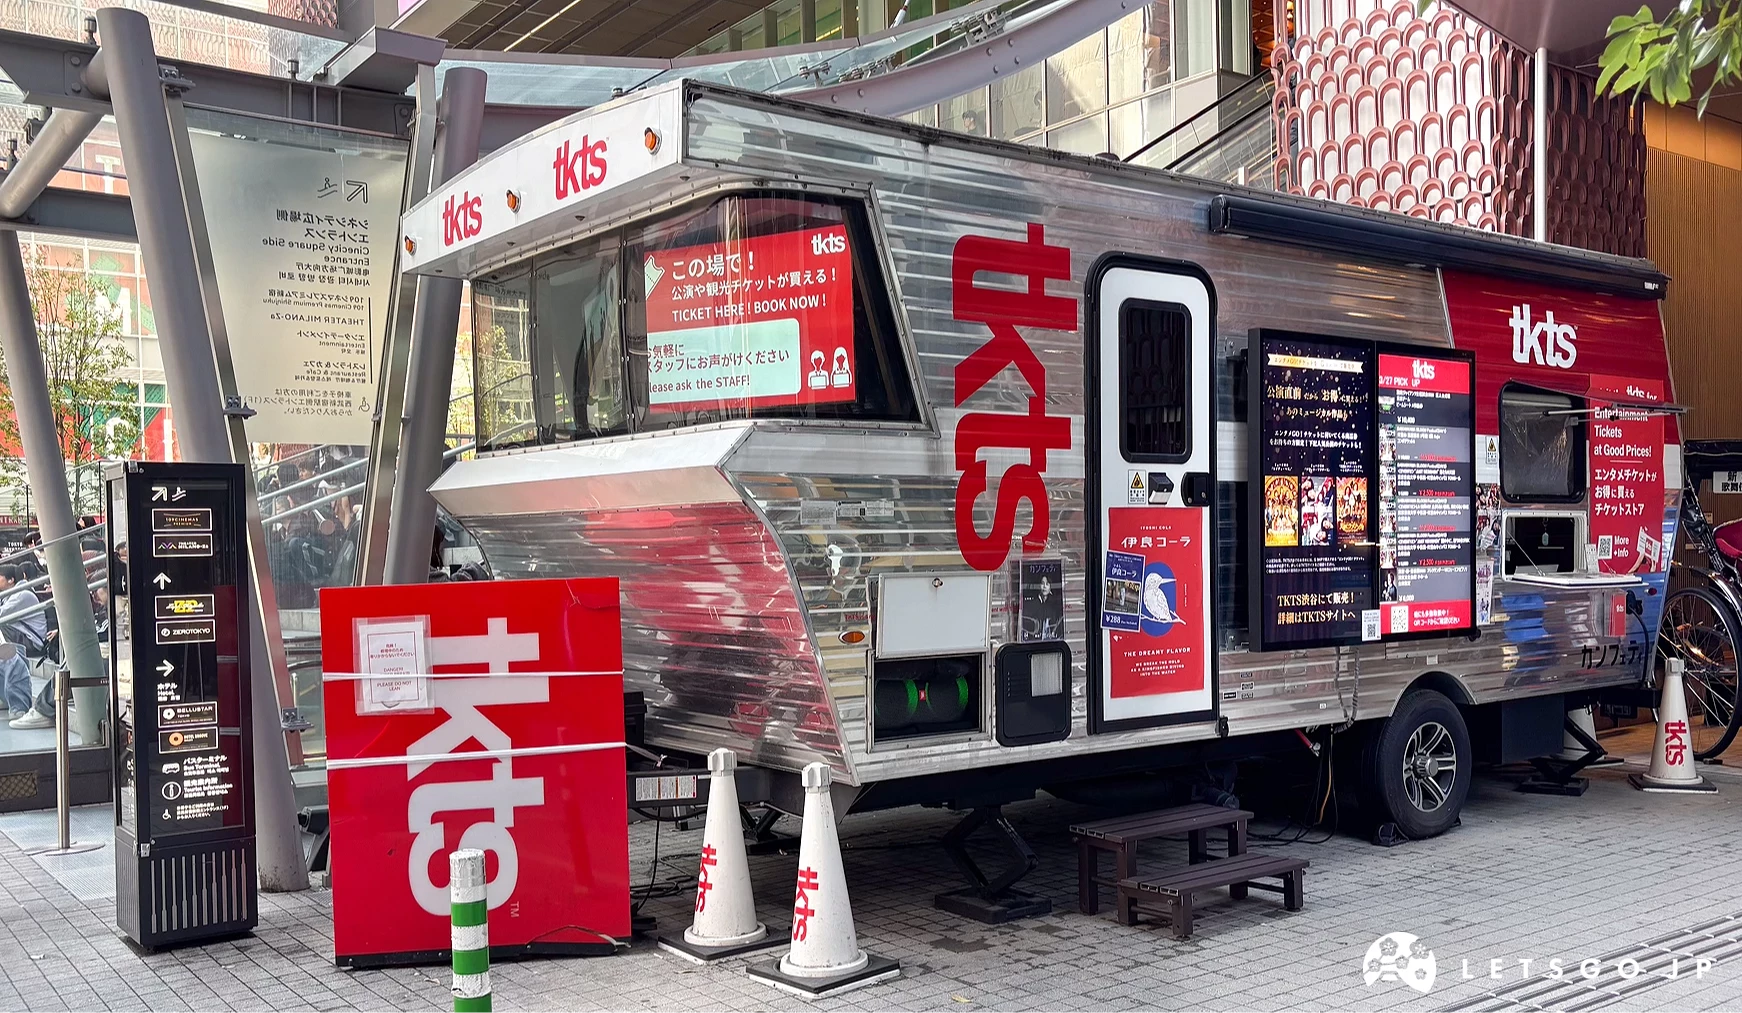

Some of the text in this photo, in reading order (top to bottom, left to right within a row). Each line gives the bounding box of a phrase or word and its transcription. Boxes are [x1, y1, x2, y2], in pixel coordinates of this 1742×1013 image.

[553, 135, 608, 200] tkts
[442, 191, 483, 247] tkts
[811, 233, 845, 255] tkts
[672, 252, 754, 281] この場で！
[671, 268, 837, 301] 公演や観光チケットが買える！
[672, 306, 712, 322] TICKET
[754, 298, 787, 314] BOOK
[1509, 303, 1577, 369] tkts
[1412, 359, 1435, 380] tkts
[649, 374, 750, 393] lease ask the STAFF!
[1394, 377, 1408, 387] PICK
[1411, 379, 1420, 388] UP
[952, 222, 1078, 572] tkts
[1594, 424, 1622, 438] Tickets
[1594, 443, 1652, 457] at Good Prices!
[1594, 467, 1657, 482] エンタメチケットが
[1594, 485, 1635, 499] お得に買える
[1594, 502, 1645, 516] チケットストア
[1121, 536, 1191, 549] 伊良コーラ
[1614, 535, 1630, 545] More
[1581, 640, 1643, 670] カンフェティ
[1664, 719, 1687, 766] tkts
[406, 617, 550, 917] tkts
[695, 843, 717, 913] tkts
[792, 866, 819, 942] tkts
